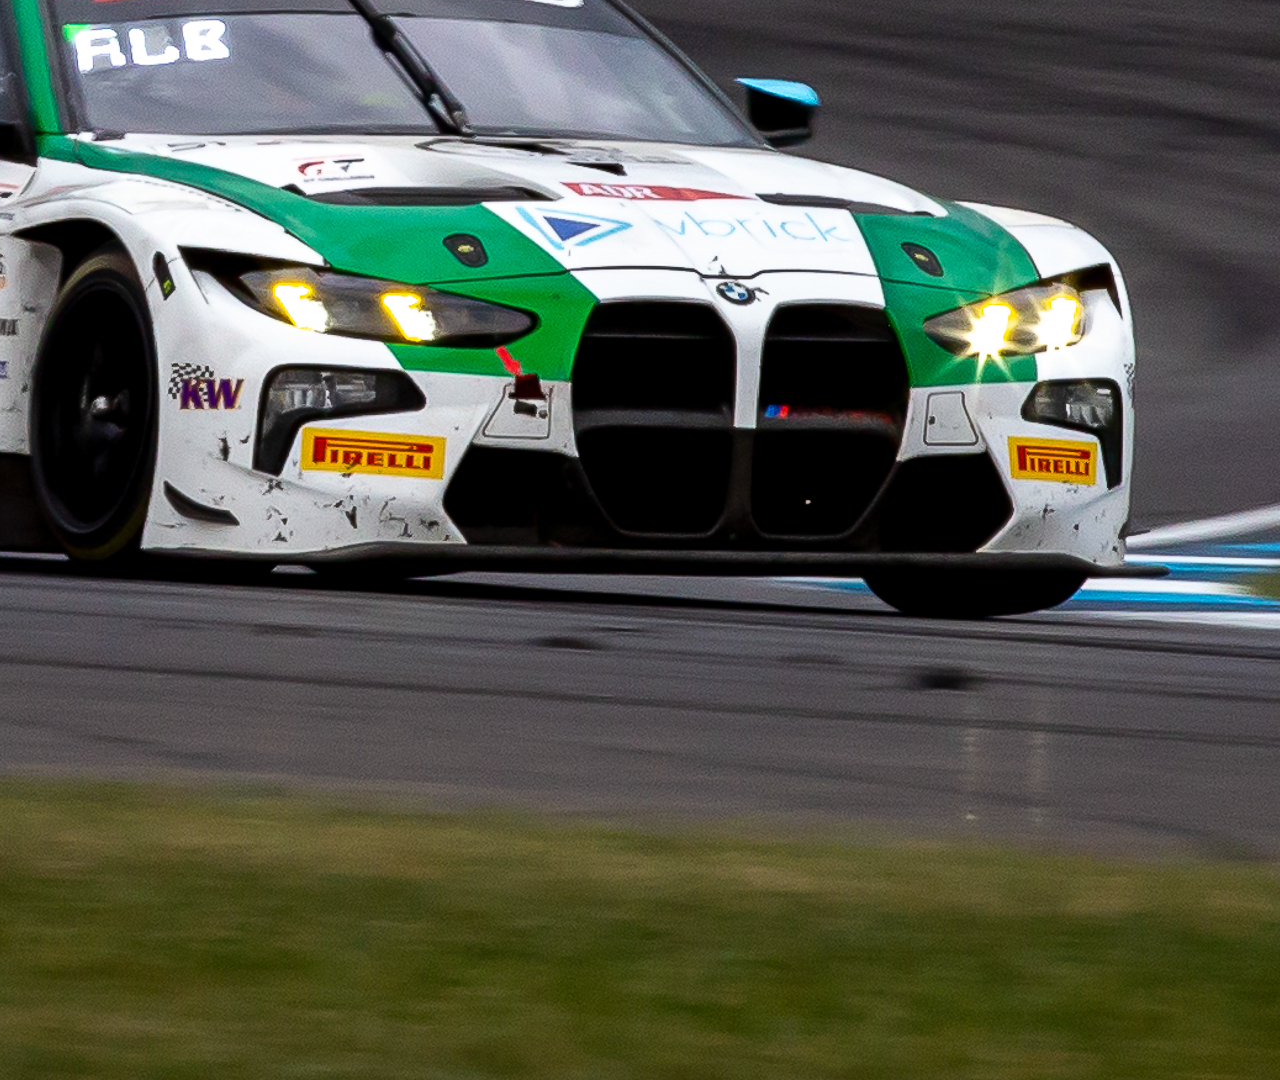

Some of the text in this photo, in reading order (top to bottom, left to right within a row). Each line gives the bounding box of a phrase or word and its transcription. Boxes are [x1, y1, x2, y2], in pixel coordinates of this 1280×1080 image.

[73, 19, 230, 74] ALB
[179, 377, 246, 410] KW
[311, 435, 434, 470] PIRELLI
[1016, 443, 1091, 477] PIRELLI
